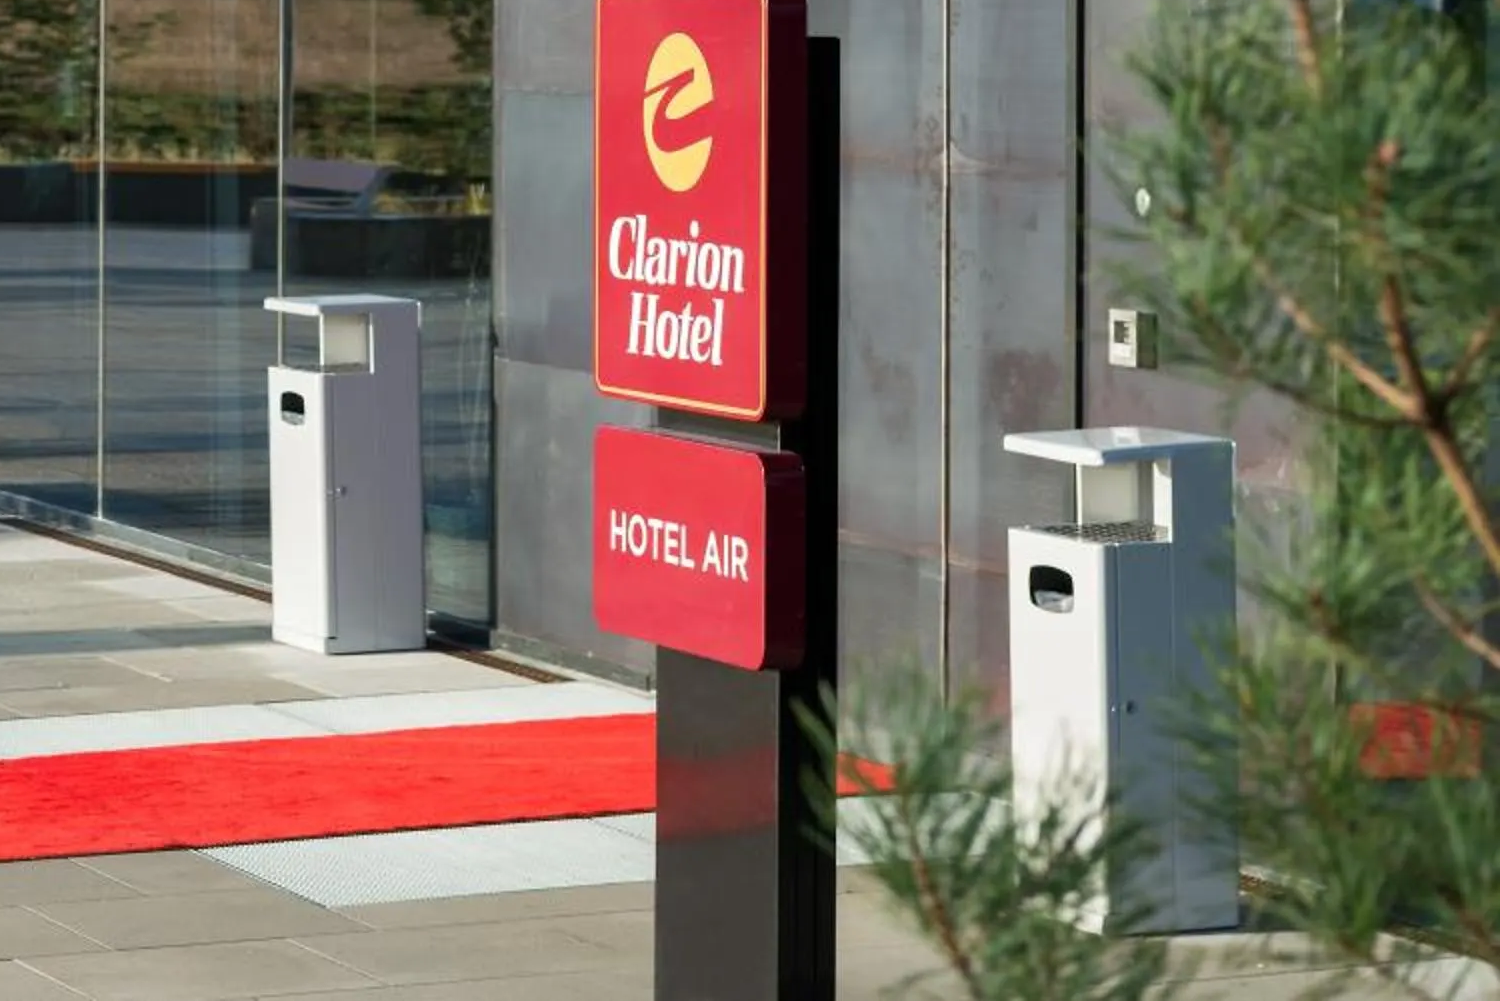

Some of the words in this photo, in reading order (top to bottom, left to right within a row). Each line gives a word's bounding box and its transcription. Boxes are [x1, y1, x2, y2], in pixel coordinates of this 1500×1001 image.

[608, 214, 745, 293] Clarion
[626, 291, 724, 366] Hotel
[609, 509, 695, 569] HOTEL
[701, 530, 749, 582] AIR
